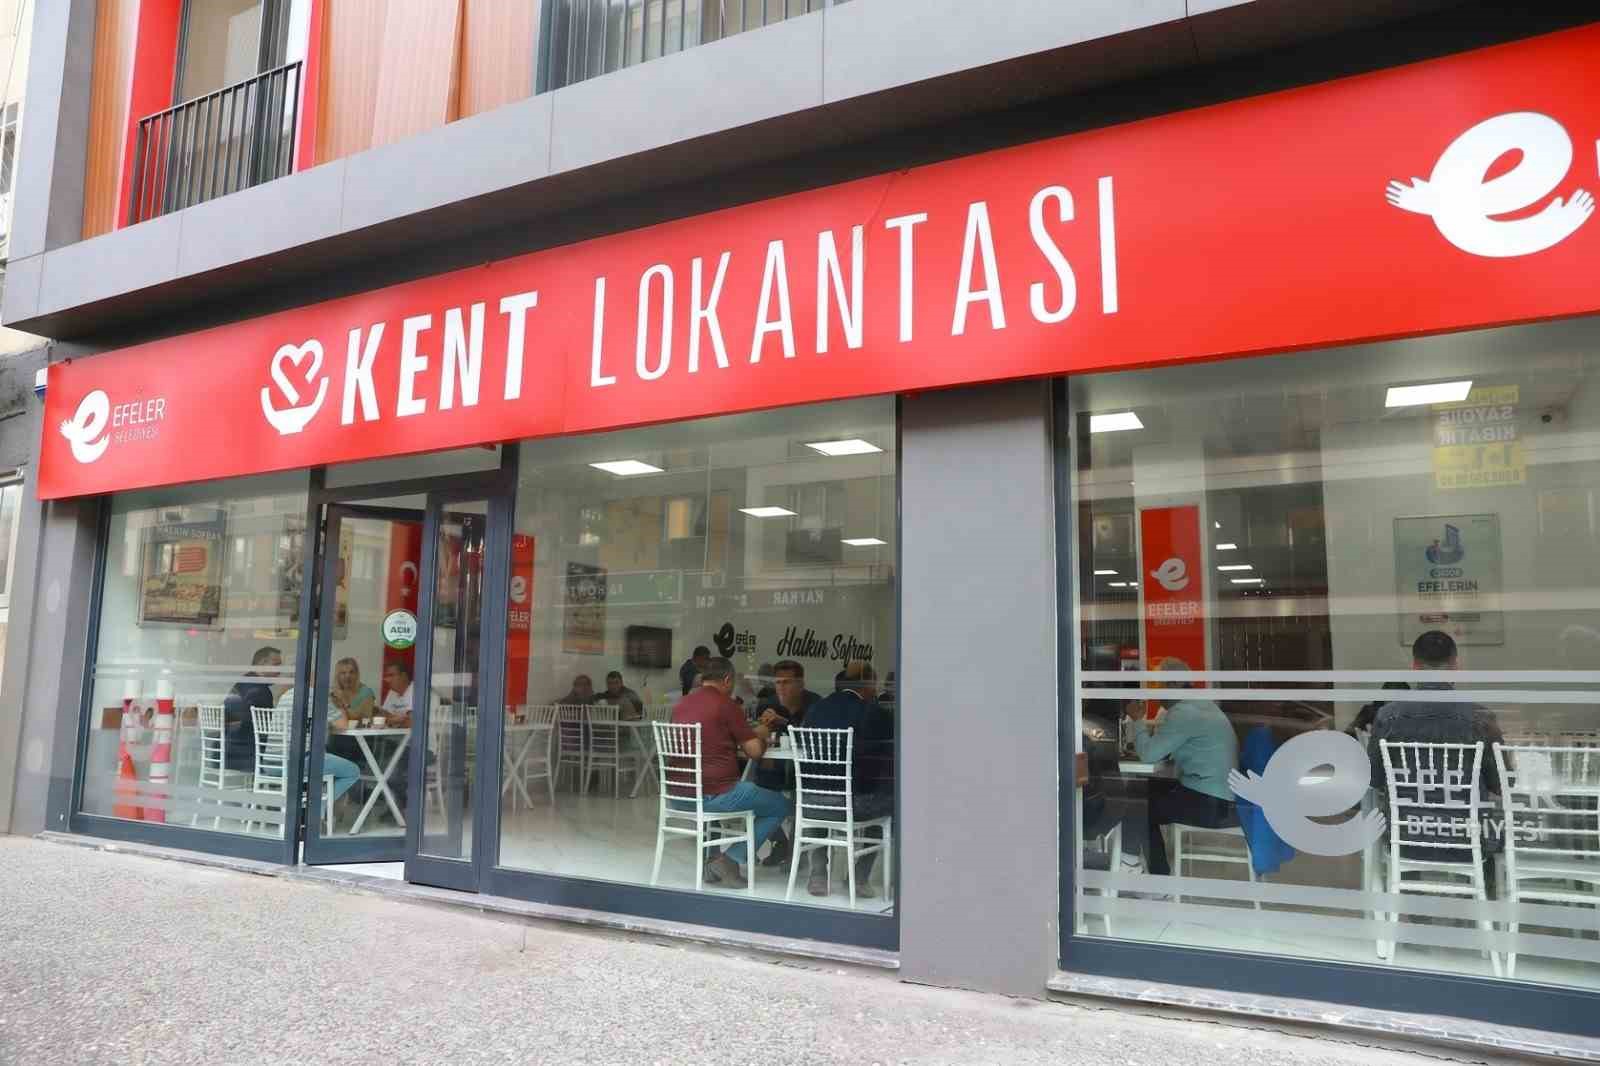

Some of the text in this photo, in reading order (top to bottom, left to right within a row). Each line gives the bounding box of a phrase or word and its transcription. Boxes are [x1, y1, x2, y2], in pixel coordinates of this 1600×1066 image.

[339, 176, 1119, 426] KENT LOKANTASI
[113, 398, 166, 427] EFELER
[1148, 601, 1199, 617] EFELER
